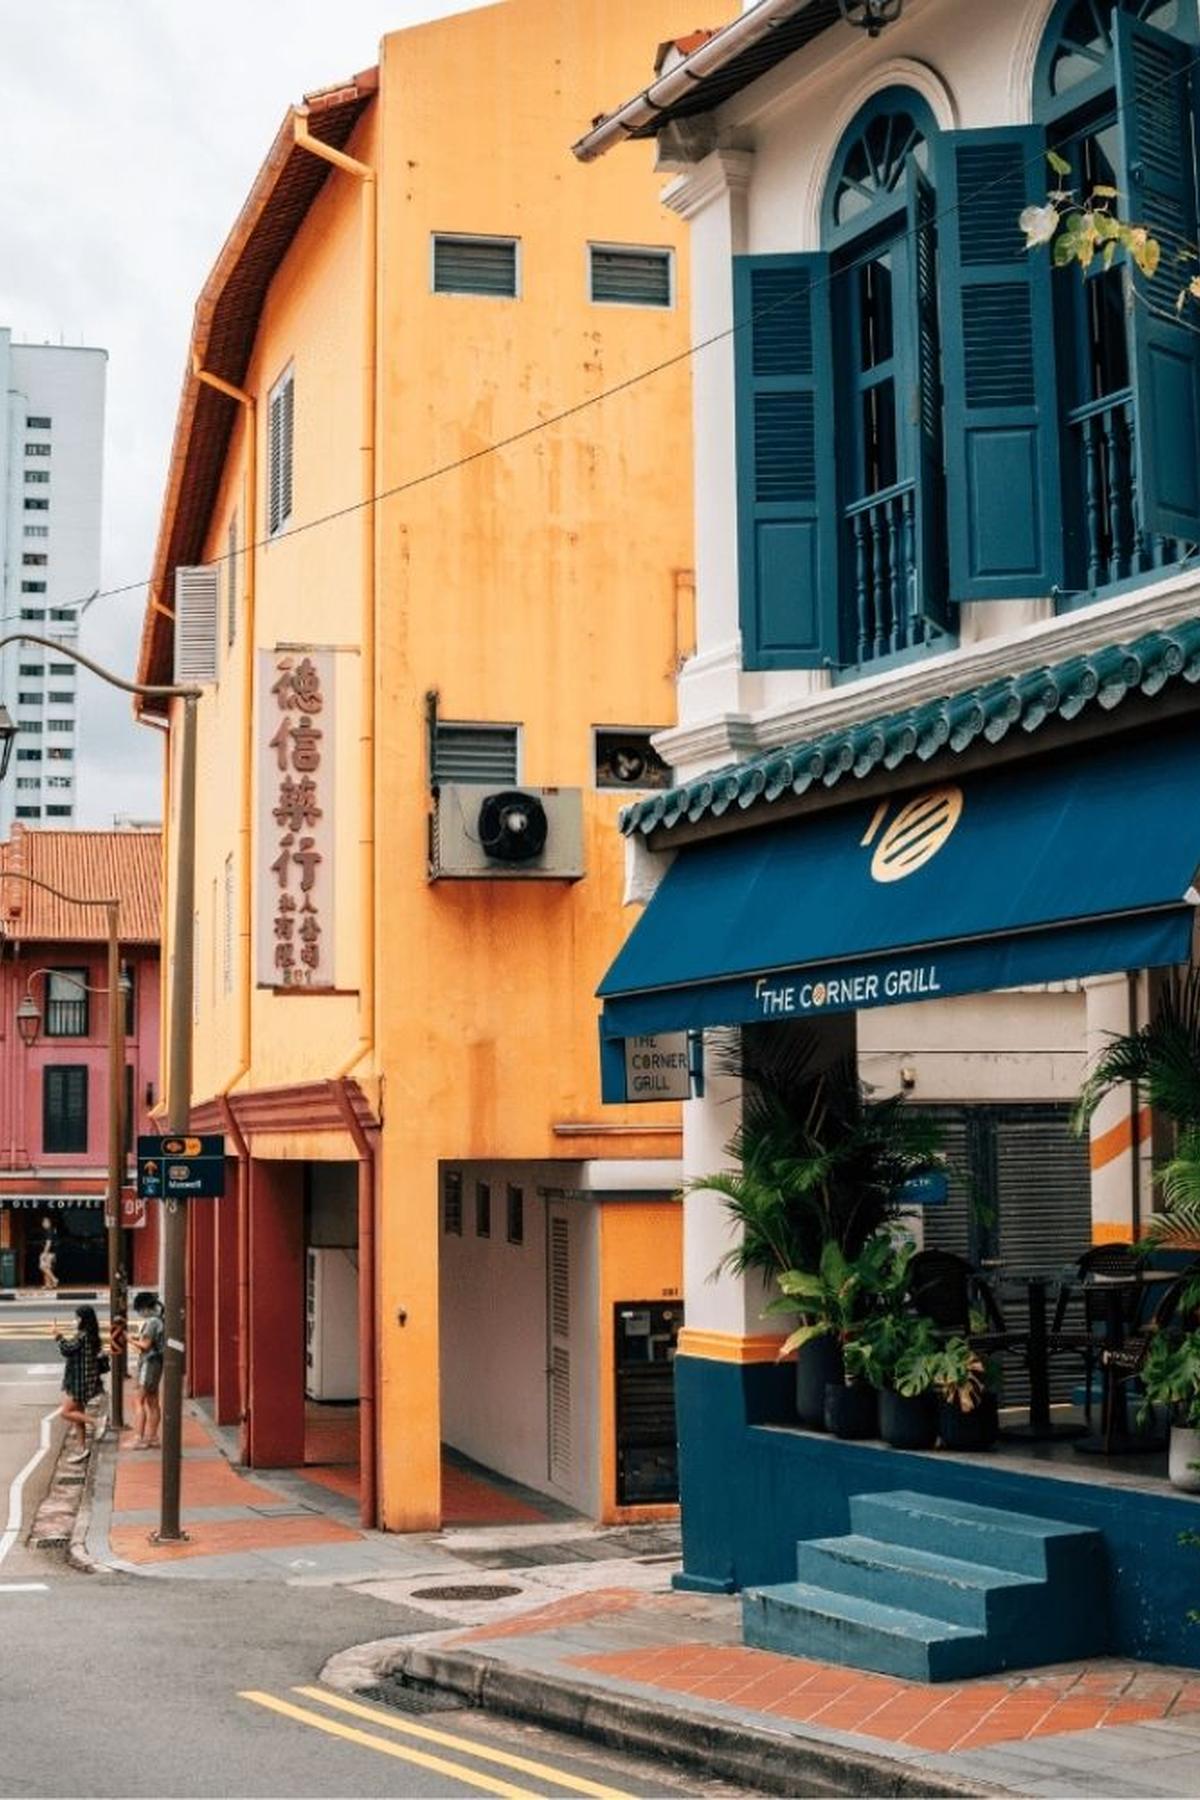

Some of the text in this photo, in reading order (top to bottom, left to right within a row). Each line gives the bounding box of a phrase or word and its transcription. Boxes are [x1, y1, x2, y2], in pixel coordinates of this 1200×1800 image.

[761, 966, 941, 1014] THE CORNER GRILL
[633, 1036, 657, 1048] THE
[632, 1052, 687, 1070] CORNER
[633, 1075, 670, 1092] GRILL
